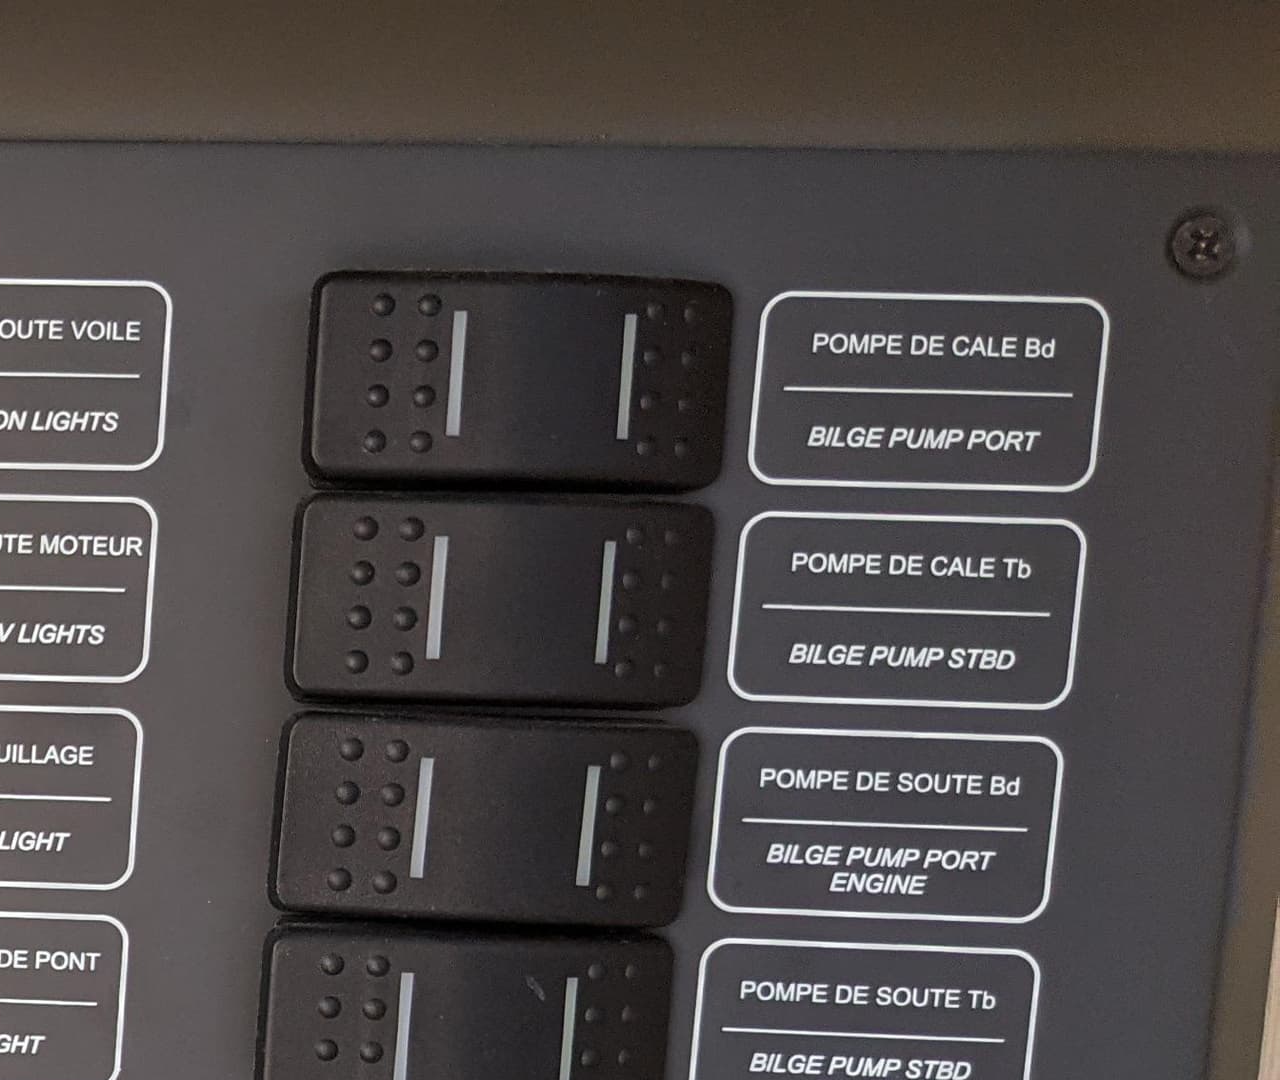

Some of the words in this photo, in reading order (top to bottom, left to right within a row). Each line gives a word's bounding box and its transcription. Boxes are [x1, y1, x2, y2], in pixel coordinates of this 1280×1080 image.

[70, 320, 141, 341] VOILE
[812, 332, 903, 355] POMPE
[910, 334, 945, 356] DE
[952, 335, 1018, 358] CALE
[1024, 337, 1056, 359] Bd
[30, 410, 119, 432] LIGHTS
[807, 426, 886, 449] BILGE
[888, 427, 965, 450] PUMP
[966, 429, 1041, 452] PORT
[39, 534, 143, 557] MOTEUR
[791, 552, 882, 575] POMPE
[888, 554, 924, 576] DE
[930, 555, 996, 578] CALE
[1002, 557, 1032, 579] Tb
[17, 623, 106, 645] LIGHTS
[788, 643, 866, 666] BILGE
[868, 645, 945, 668] PUMP
[947, 647, 1016, 670] STBD
[759, 767, 850, 791] POMPE
[855, 771, 891, 792] DE
[897, 772, 983, 795] SOUTE
[989, 775, 1021, 796] Bd
[766, 843, 843, 866] BILGE
[845, 846, 921, 868] PUMP
[922, 849, 997, 871] PORT
[829, 871, 928, 895] ENGINE
[34, 950, 101, 971] PONT
[740, 980, 829, 1003] POMPE
[834, 984, 870, 1005] DE
[875, 986, 961, 1009] SOUTE
[967, 989, 996, 1010] Tb
[749, 1052, 825, 1075] BILGE
[827, 1056, 902, 1078] PUMP
[905, 1059, 972, 1080] STBD
